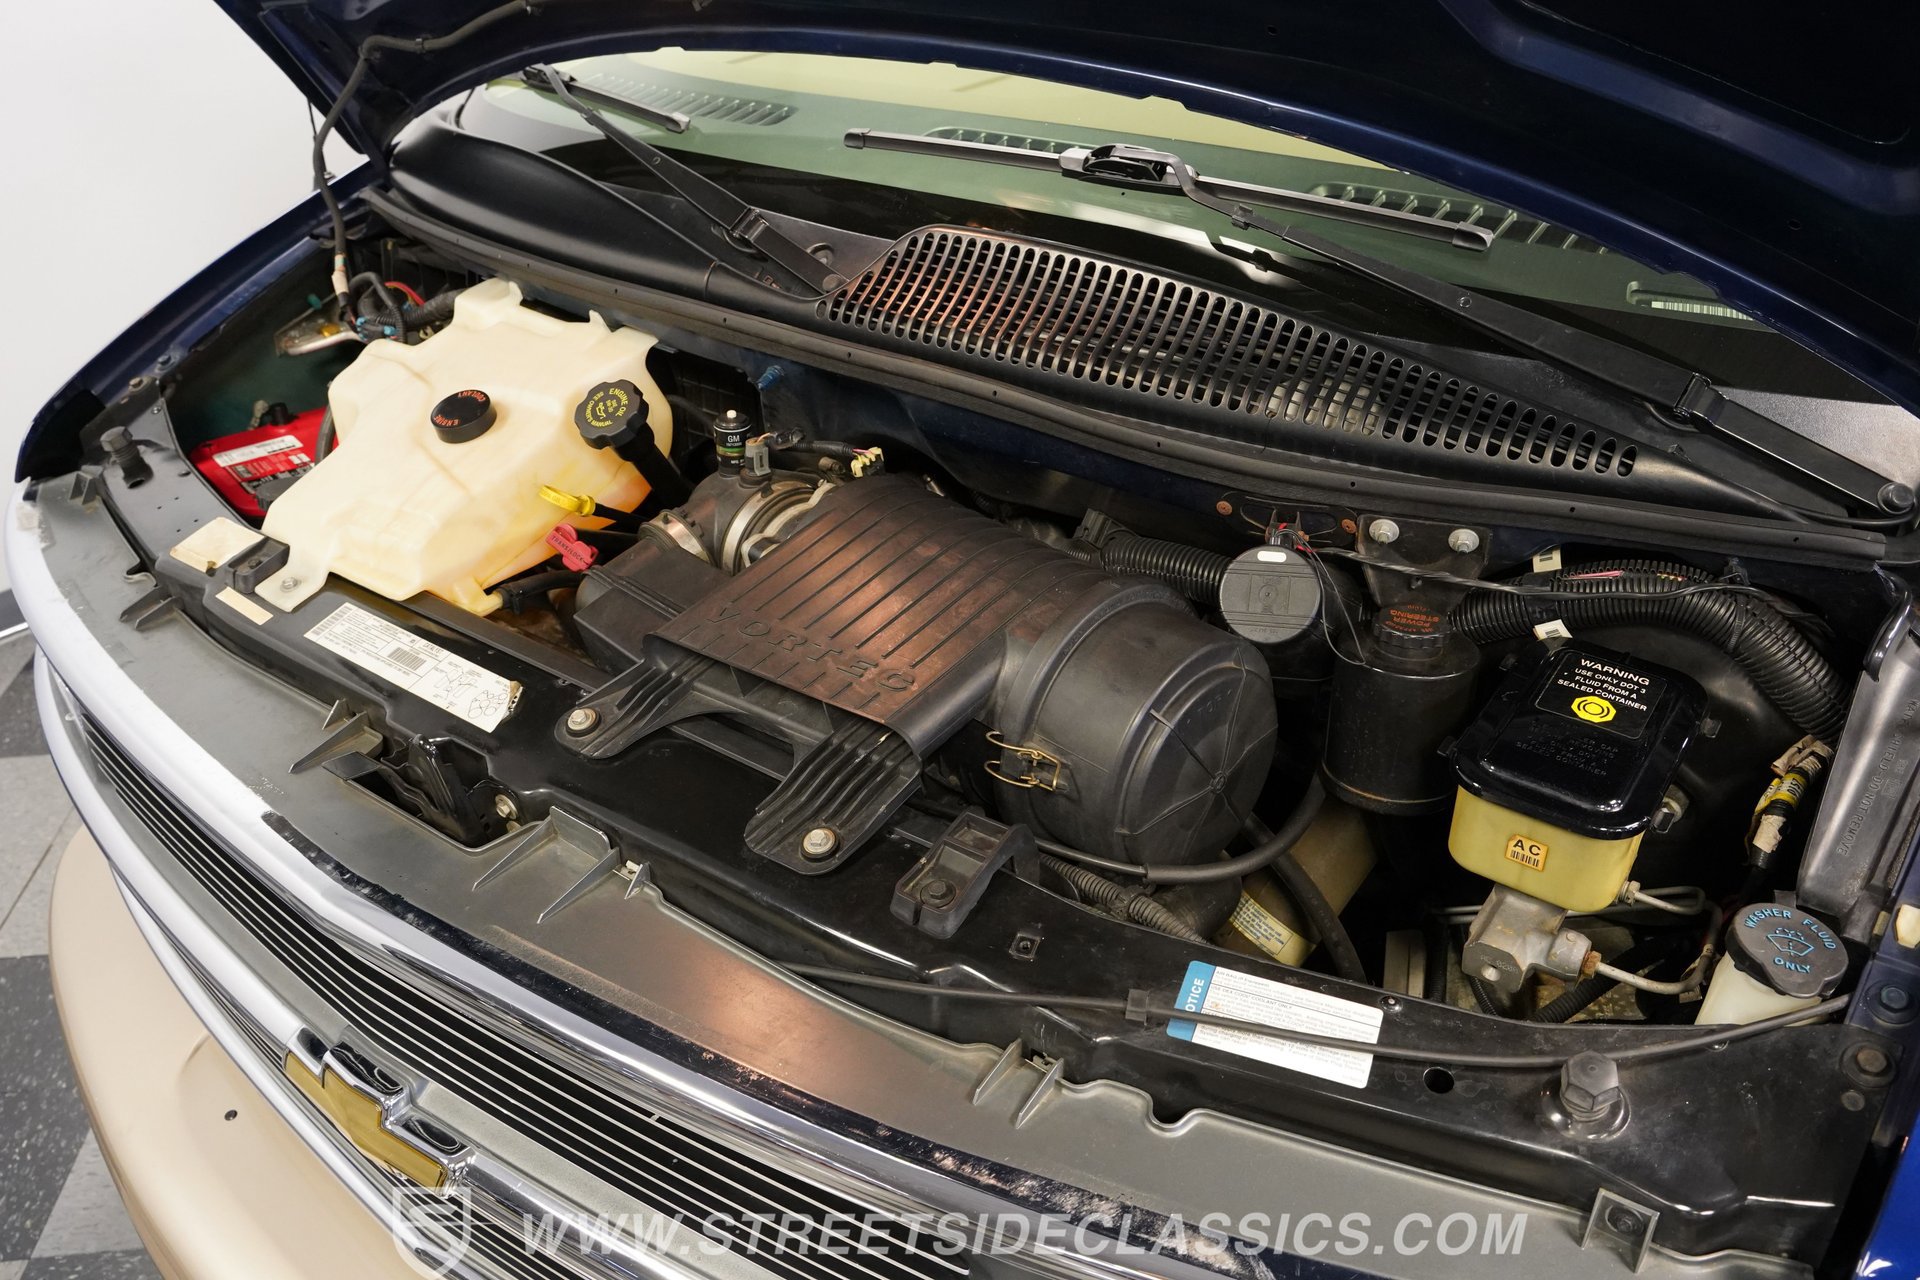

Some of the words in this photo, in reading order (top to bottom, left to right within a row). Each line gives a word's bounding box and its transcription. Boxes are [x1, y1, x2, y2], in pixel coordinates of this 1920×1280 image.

[593, 392, 604, 401] SEE
[609, 388, 628, 405] ENGINE
[615, 407, 626, 416] OIL
[1390, 609, 1440, 622] STEERING
[1393, 617, 1431, 627] POWER
[706, 606, 916, 692] VORTEC
[1575, 668, 1593, 677] USE
[1595, 673, 1619, 685] ONLY
[1620, 681, 1639, 691] DOT
[1581, 659, 1650, 686] WARNING
[1557, 679, 1594, 693] SEALED
[1595, 689, 1648, 712] CONTAINER
[1575, 675, 1601, 687] FLUID
[1602, 683, 1629, 696] FROM
[1838, 814, 1864, 856] REMOVE
[1513, 839, 1541, 856] AC
[1744, 908, 1791, 928] WASHER
[1802, 919, 1837, 949] FLUID
[1775, 957, 1811, 973] ONLY
[1185, 977, 1205, 1012] OTICE
